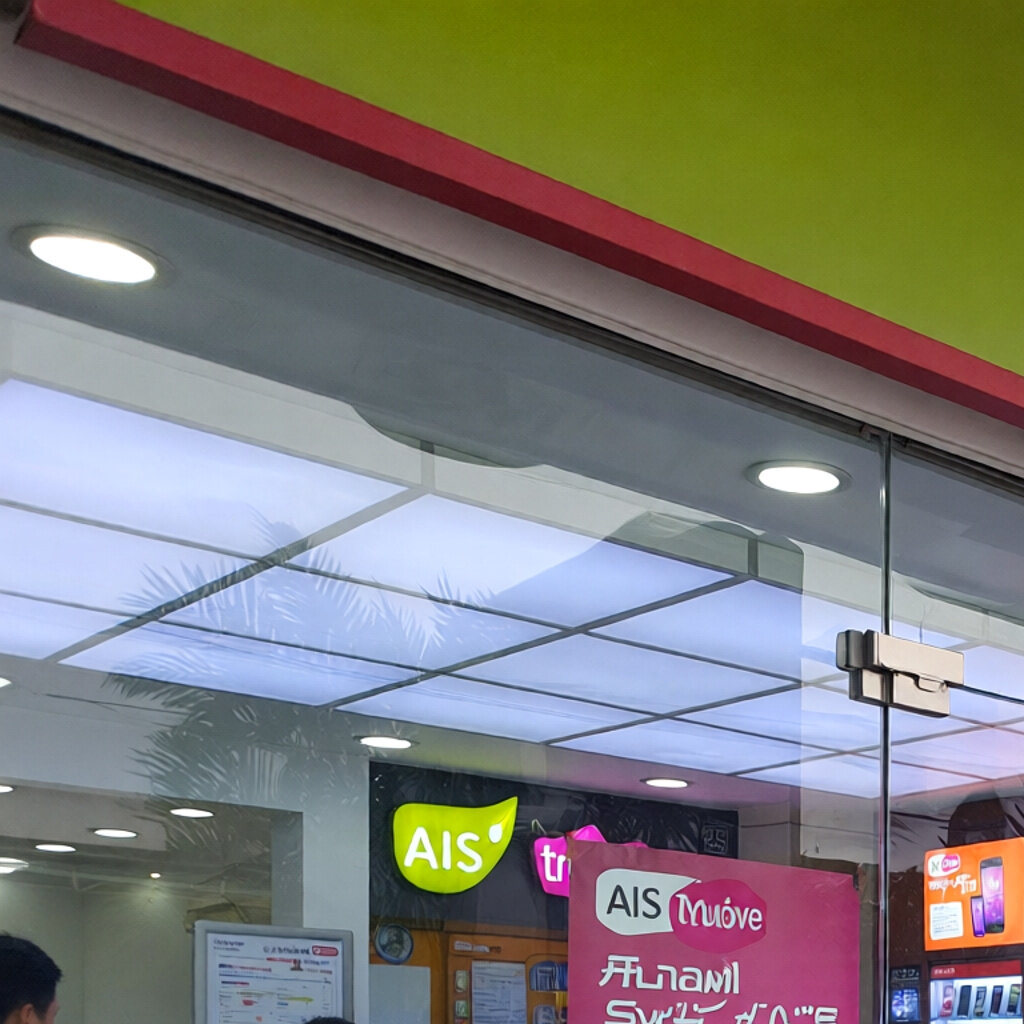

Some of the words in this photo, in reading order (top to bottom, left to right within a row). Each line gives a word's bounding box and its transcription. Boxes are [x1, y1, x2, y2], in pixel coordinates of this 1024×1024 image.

[402, 826, 483, 874] AIS
[540, 844, 571, 883] tr
[606, 884, 662, 920] AIS
